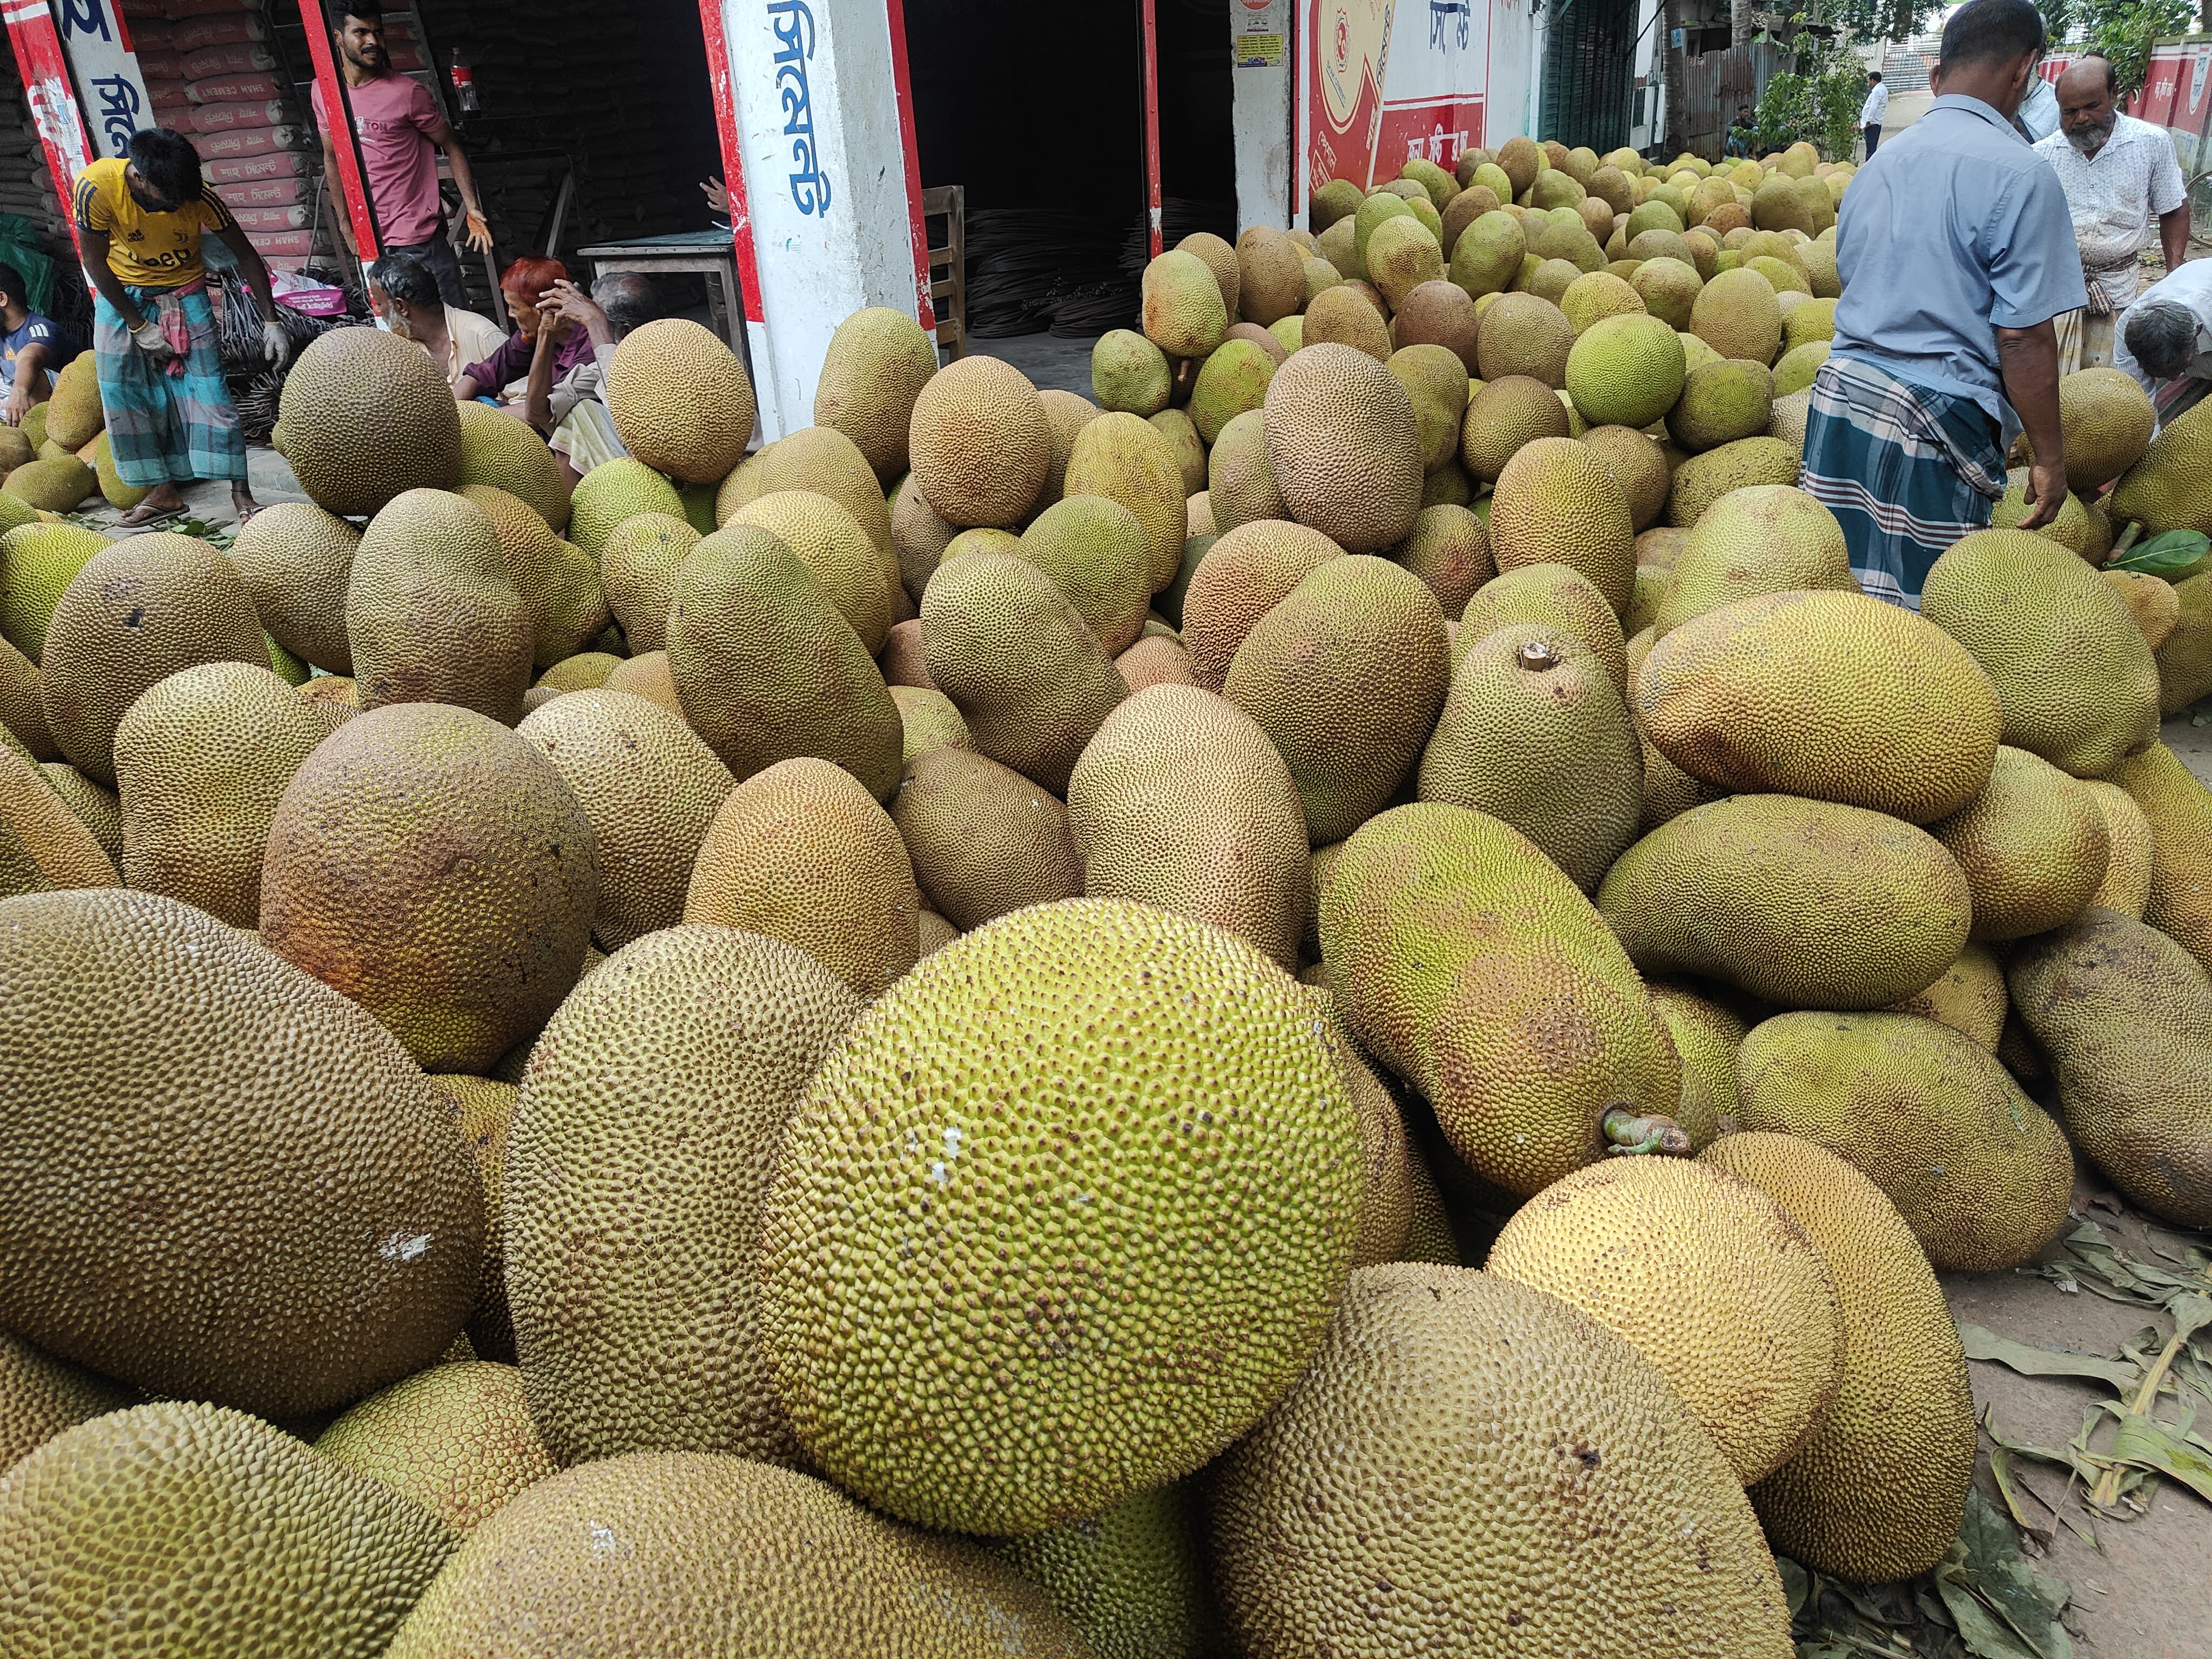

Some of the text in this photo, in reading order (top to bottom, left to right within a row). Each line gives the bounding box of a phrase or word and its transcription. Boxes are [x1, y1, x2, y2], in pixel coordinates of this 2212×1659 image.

[202, 84, 265, 98] SHAH CEMENT
[767, 0, 831, 218] সিমেন্ট
[245, 159, 276, 176] সিমেন্ট
[251, 187, 281, 201] সিমেন্ট
[275, 236, 299, 245] SHAH
